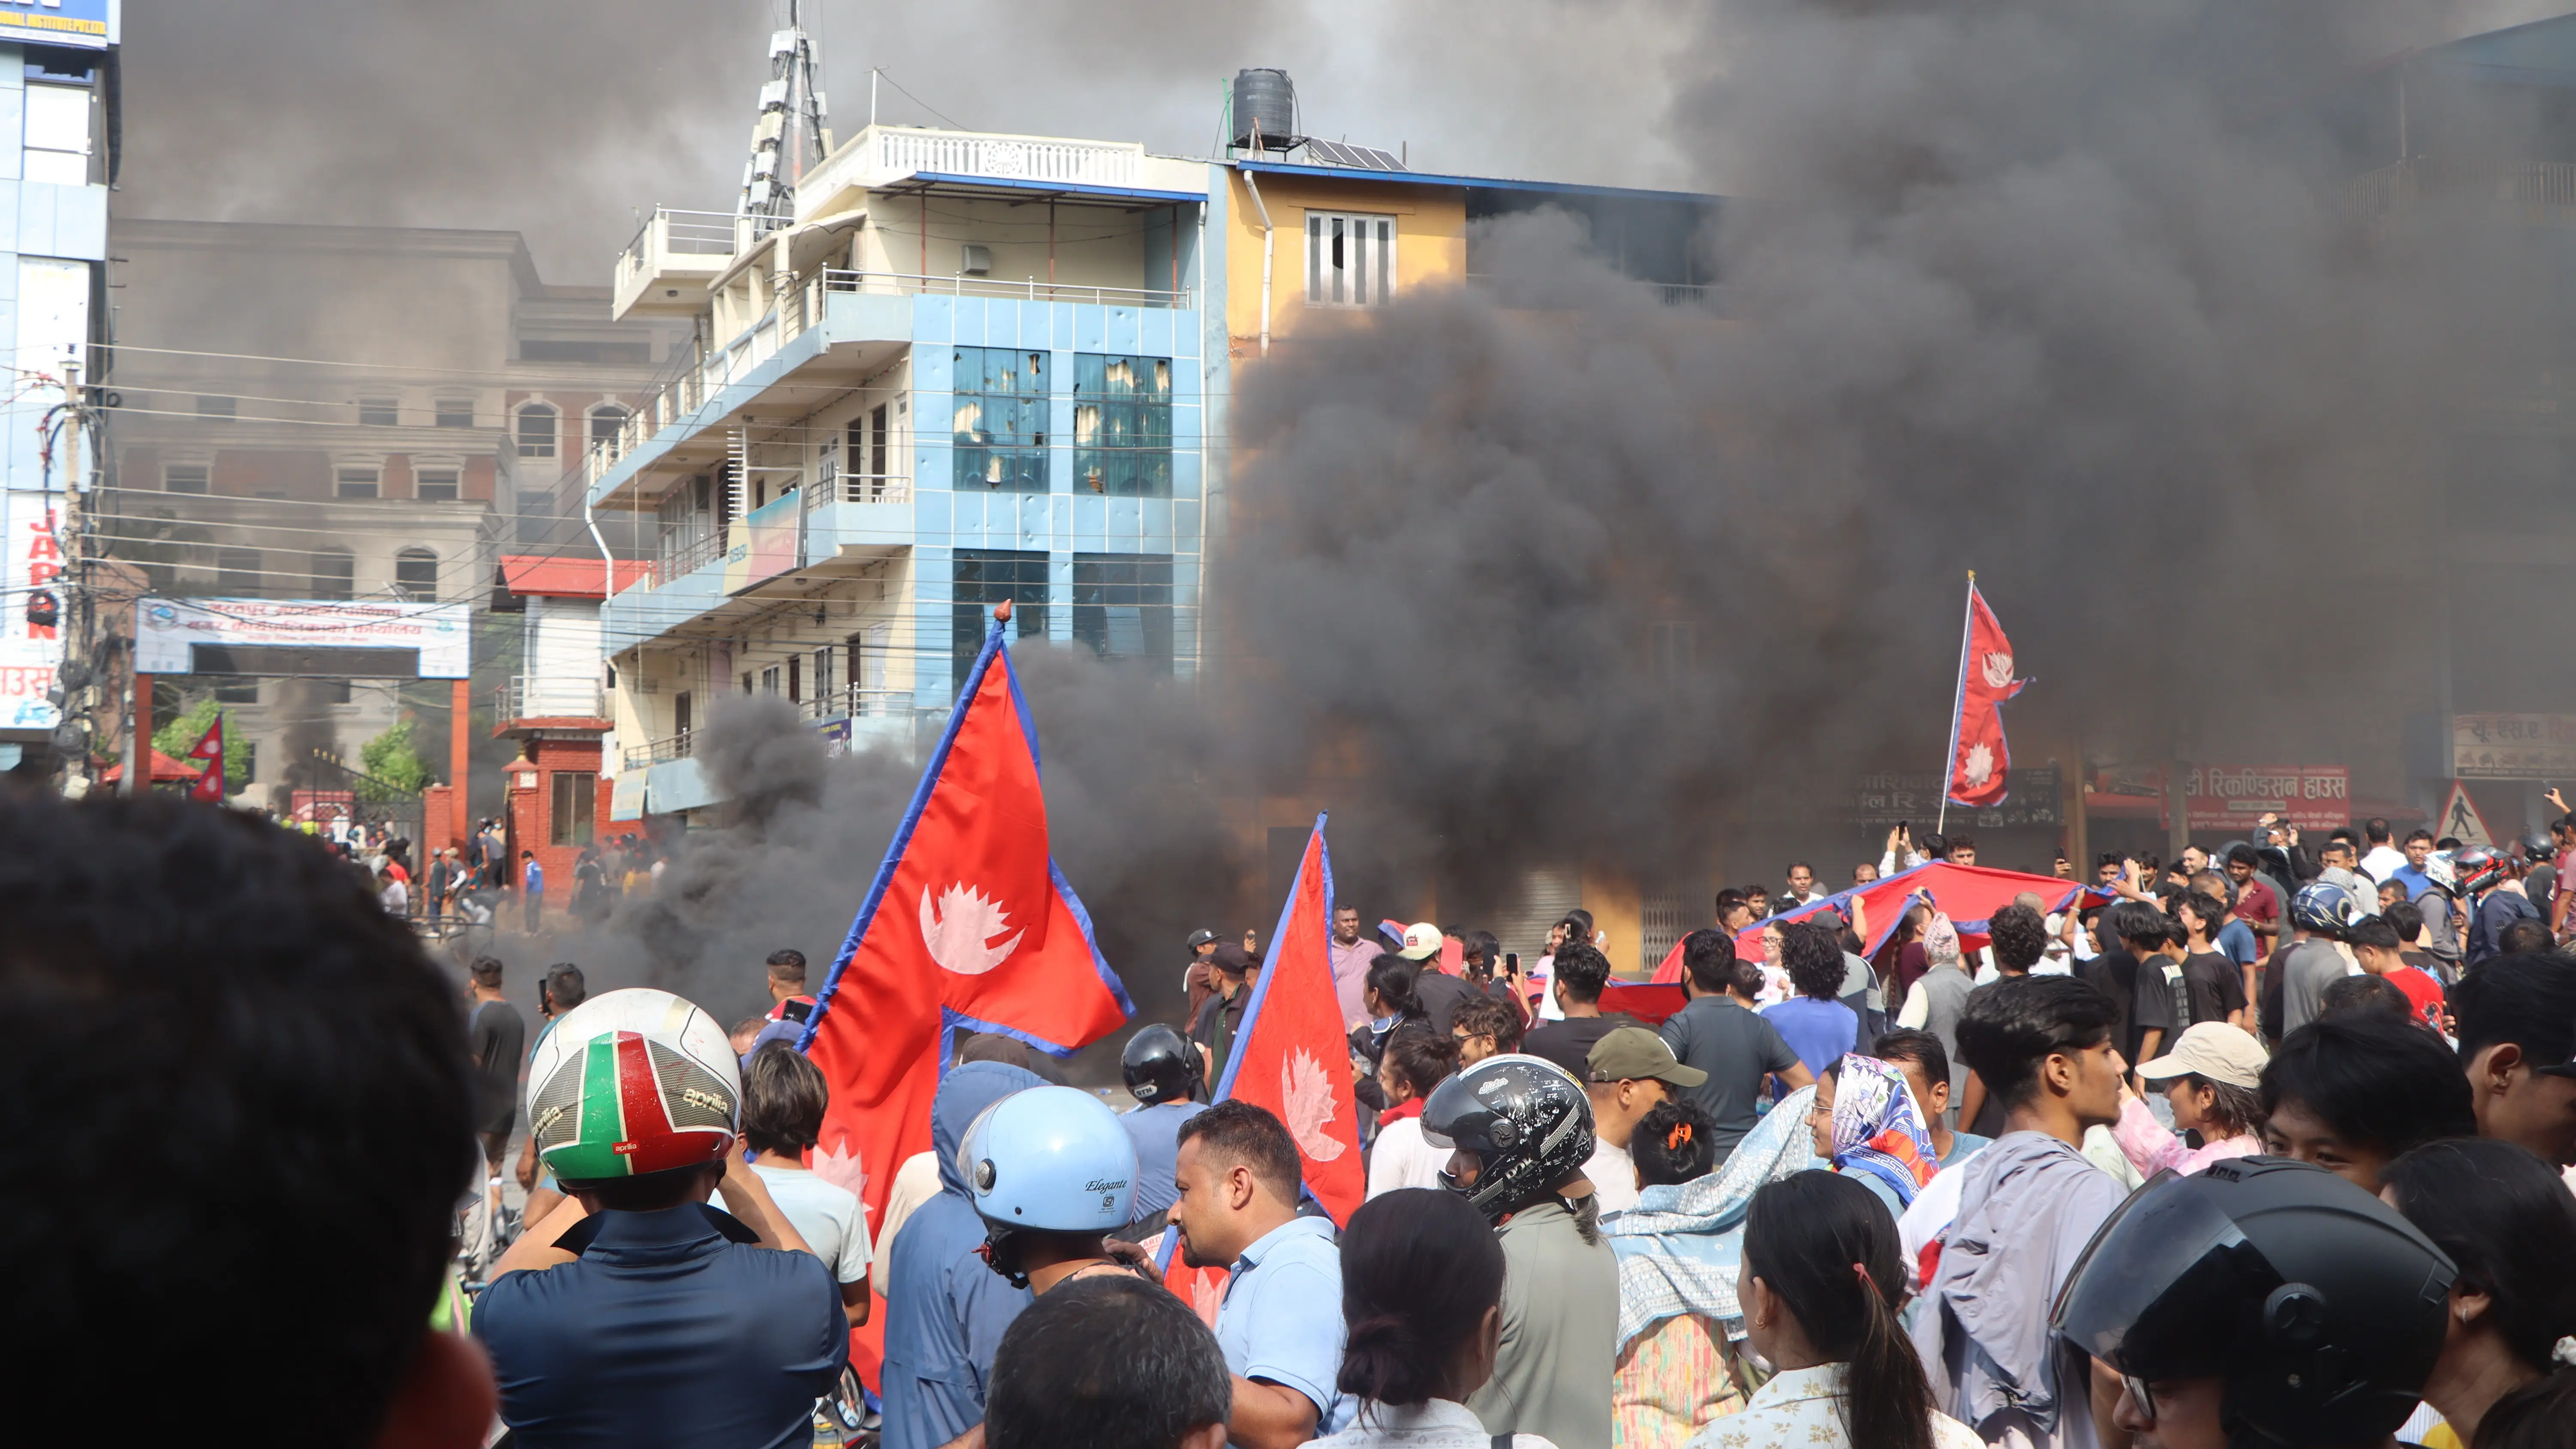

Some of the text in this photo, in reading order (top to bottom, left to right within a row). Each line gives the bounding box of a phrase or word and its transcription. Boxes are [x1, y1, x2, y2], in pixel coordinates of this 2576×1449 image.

[2303, 776, 2347, 800] हाउस
[683, 1088, 728, 1114] aprilia
[615, 1142, 638, 1152] aprilia
[1085, 1179, 1127, 1194] Elegante
